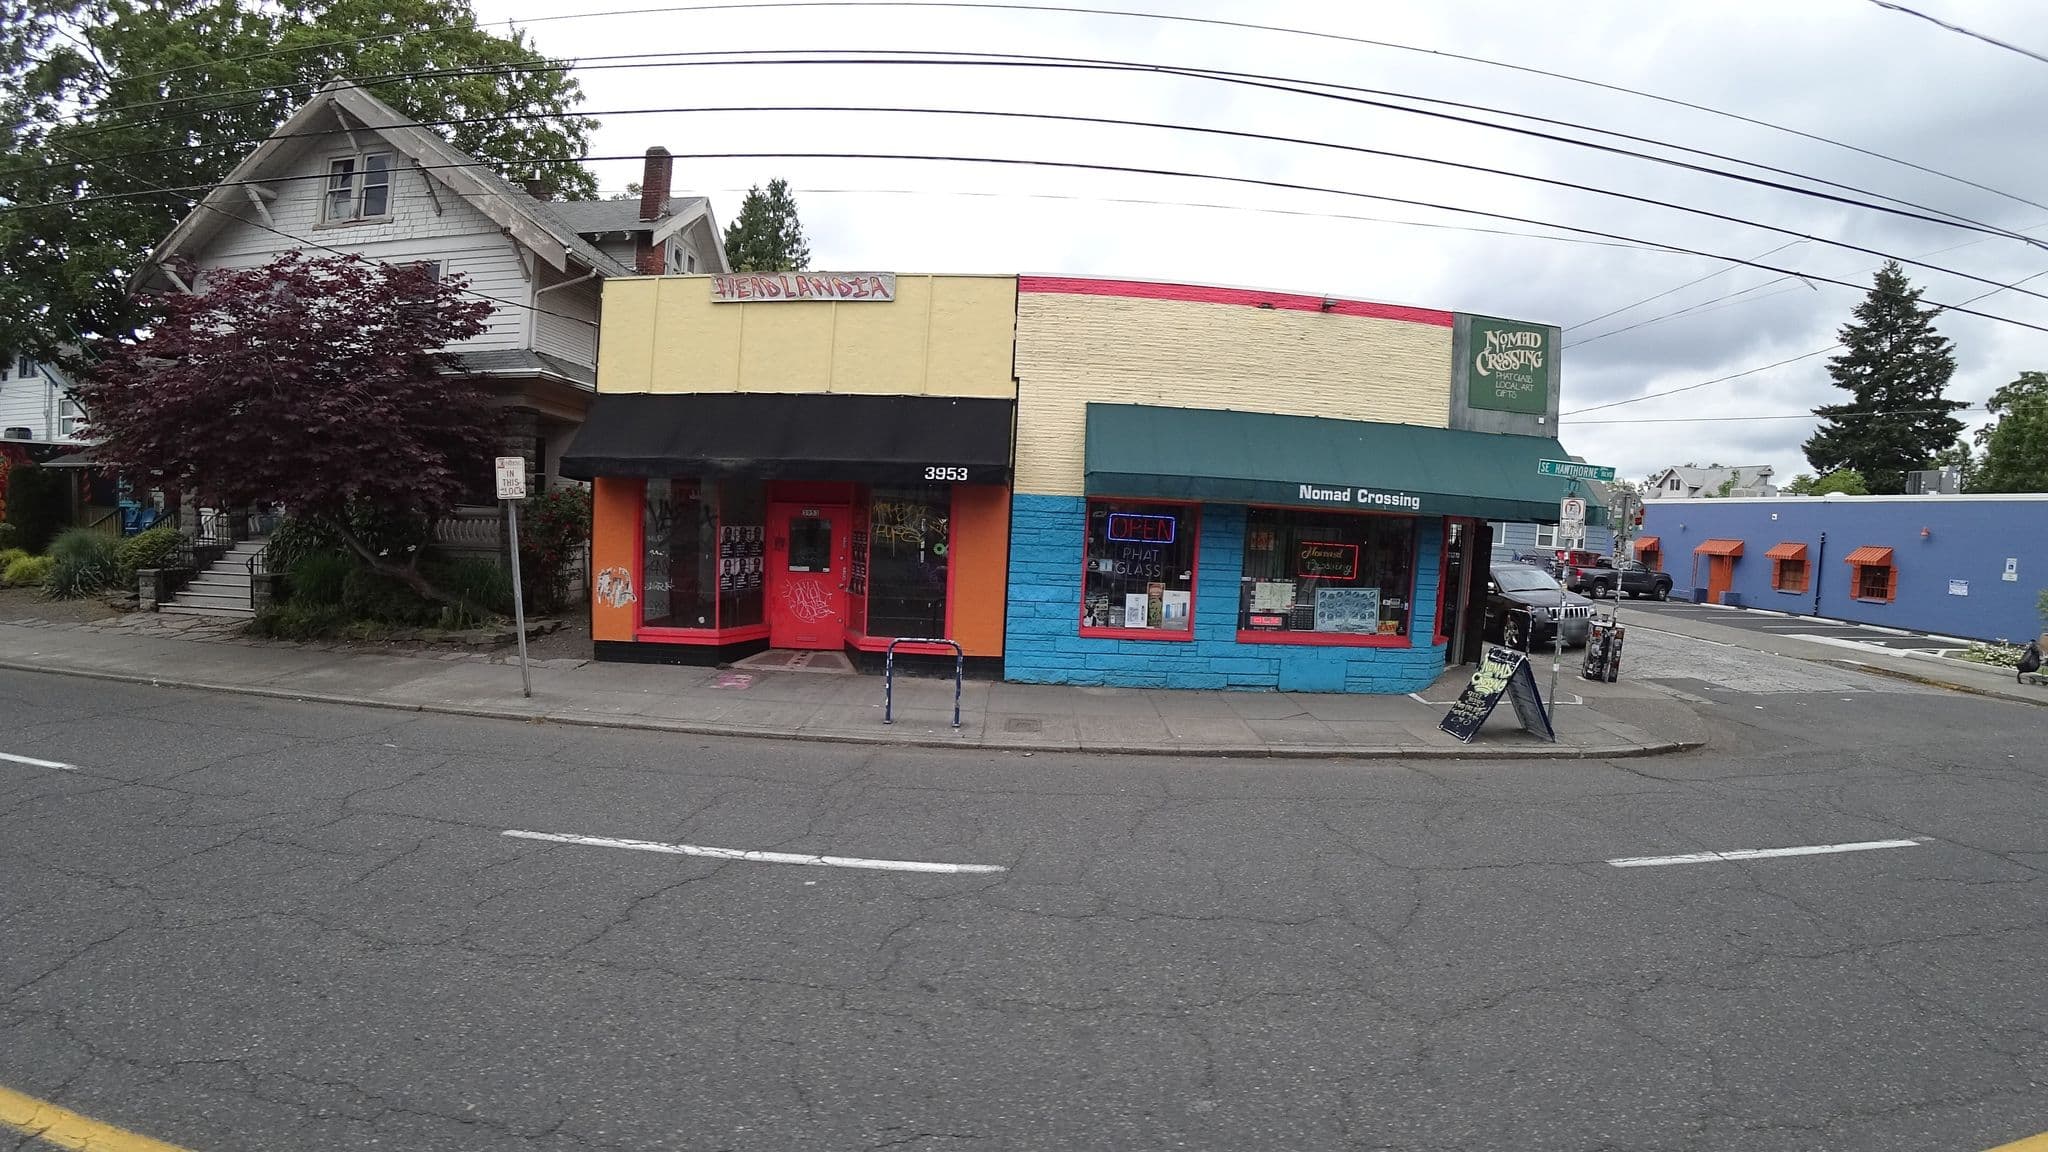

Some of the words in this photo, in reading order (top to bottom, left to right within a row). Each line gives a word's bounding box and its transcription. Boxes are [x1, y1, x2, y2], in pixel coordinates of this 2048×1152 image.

[715, 276, 890, 298] HEADLANDIA
[1484, 330, 1542, 353] NOMAD
[1476, 347, 1544, 376] CROSSING
[1496, 381, 1520, 391] LOCAL
[1521, 384, 1535, 392] ART
[506, 469, 515, 478] IN
[924, 466, 968, 480] 3953
[1541, 462, 1550, 473] SE
[1555, 464, 1598, 479] HAWTHORNE
[502, 478, 520, 487] THIS
[1299, 484, 1351, 502] Nomad
[1357, 489, 1420, 510] Crossing
[1111, 518, 1172, 541] OPEN
[1122, 548, 1160, 562] PHAT
[1115, 561, 1161, 578] GLASS
